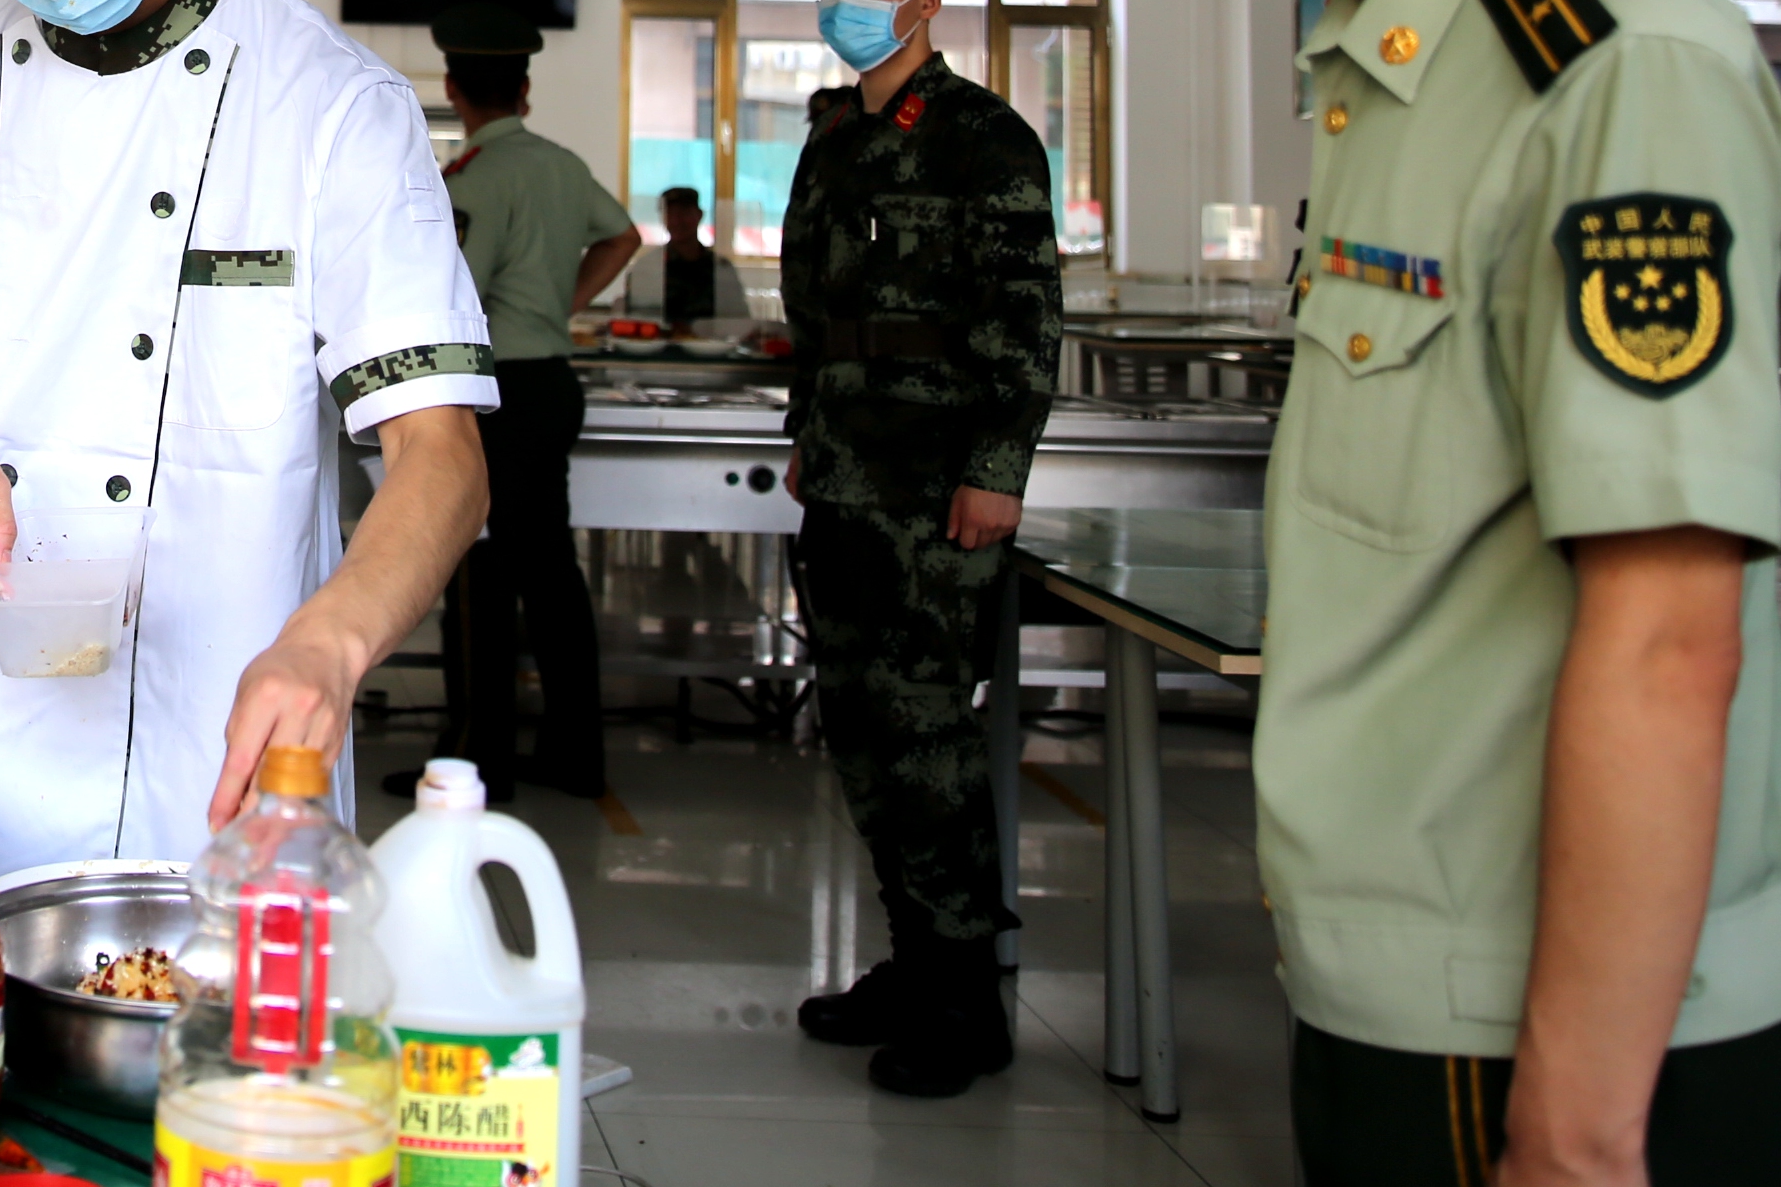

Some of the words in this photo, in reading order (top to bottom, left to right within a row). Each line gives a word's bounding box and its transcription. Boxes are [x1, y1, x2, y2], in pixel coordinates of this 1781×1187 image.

[1579, 205, 1713, 235] 中国人民
[1581, 235, 1713, 260] 武装警察部队
